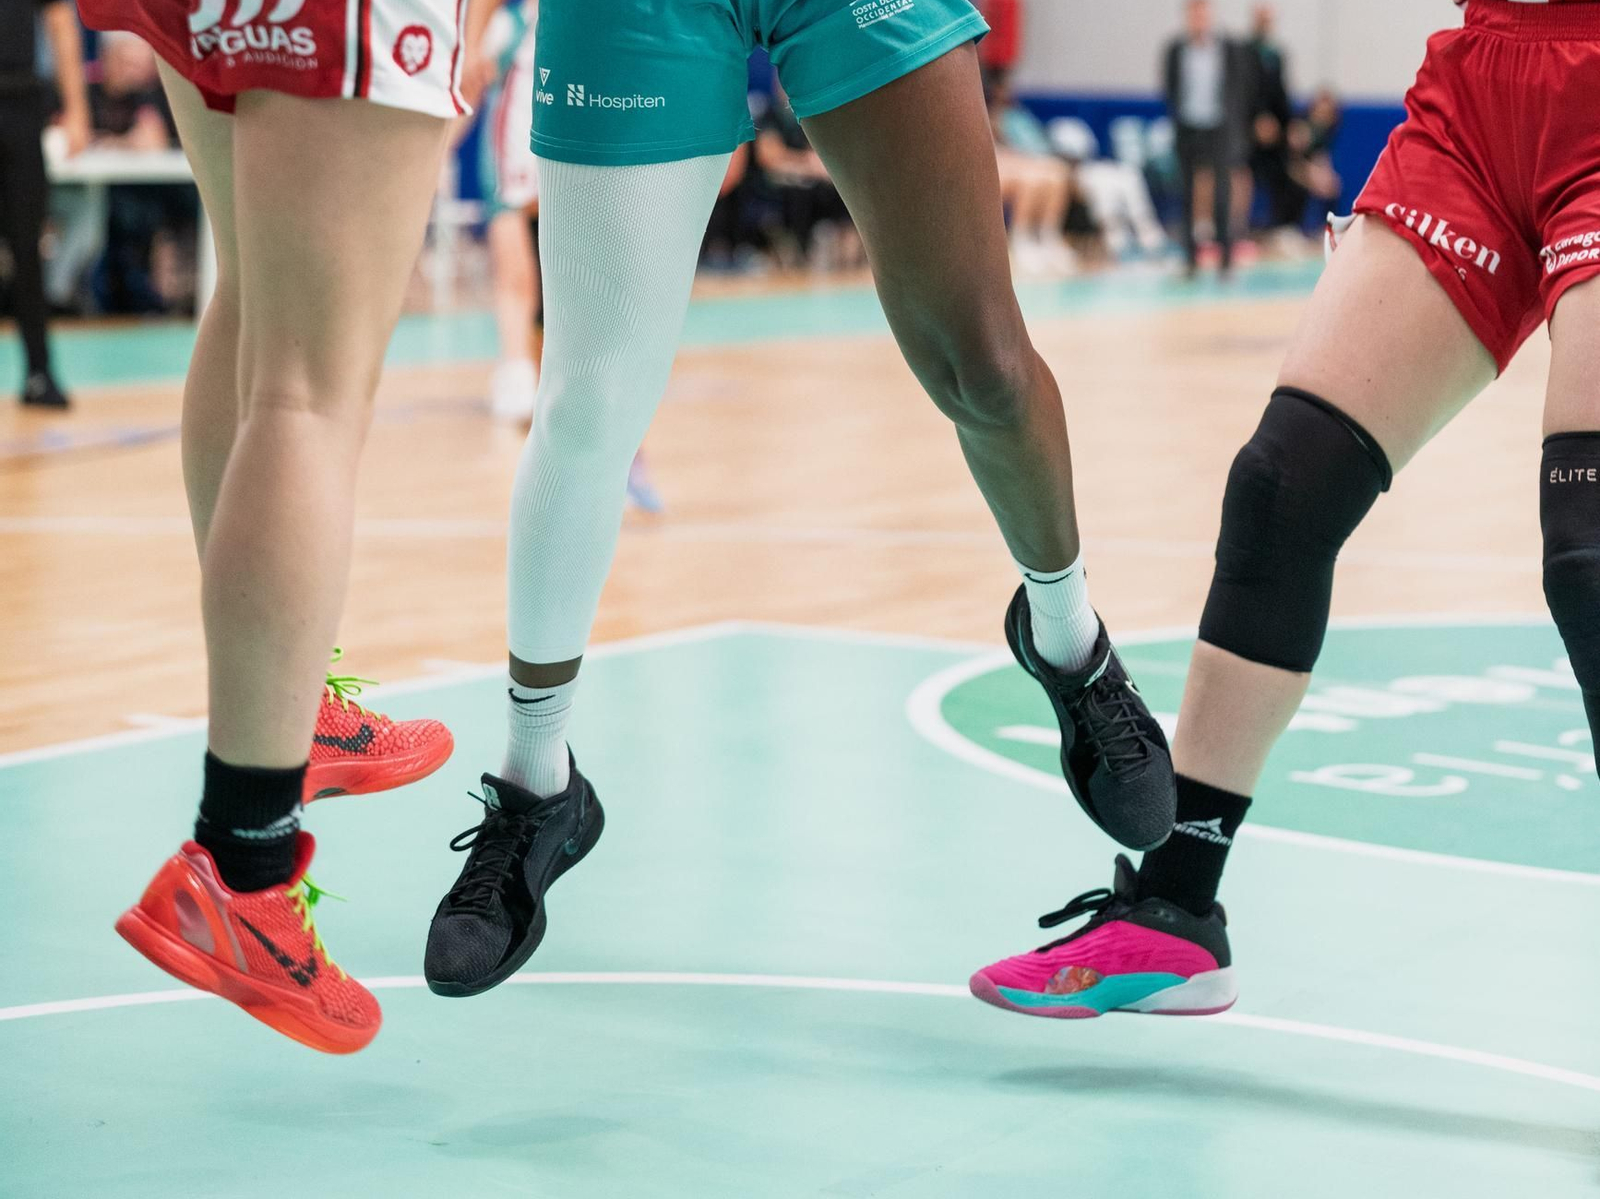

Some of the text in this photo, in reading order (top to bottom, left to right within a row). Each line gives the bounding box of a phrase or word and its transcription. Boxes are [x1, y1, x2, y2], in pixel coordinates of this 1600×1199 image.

[852, 1, 878, 17] COSTA
[536, 88, 554, 105] vive
[589, 94, 665, 111] Hospiten
